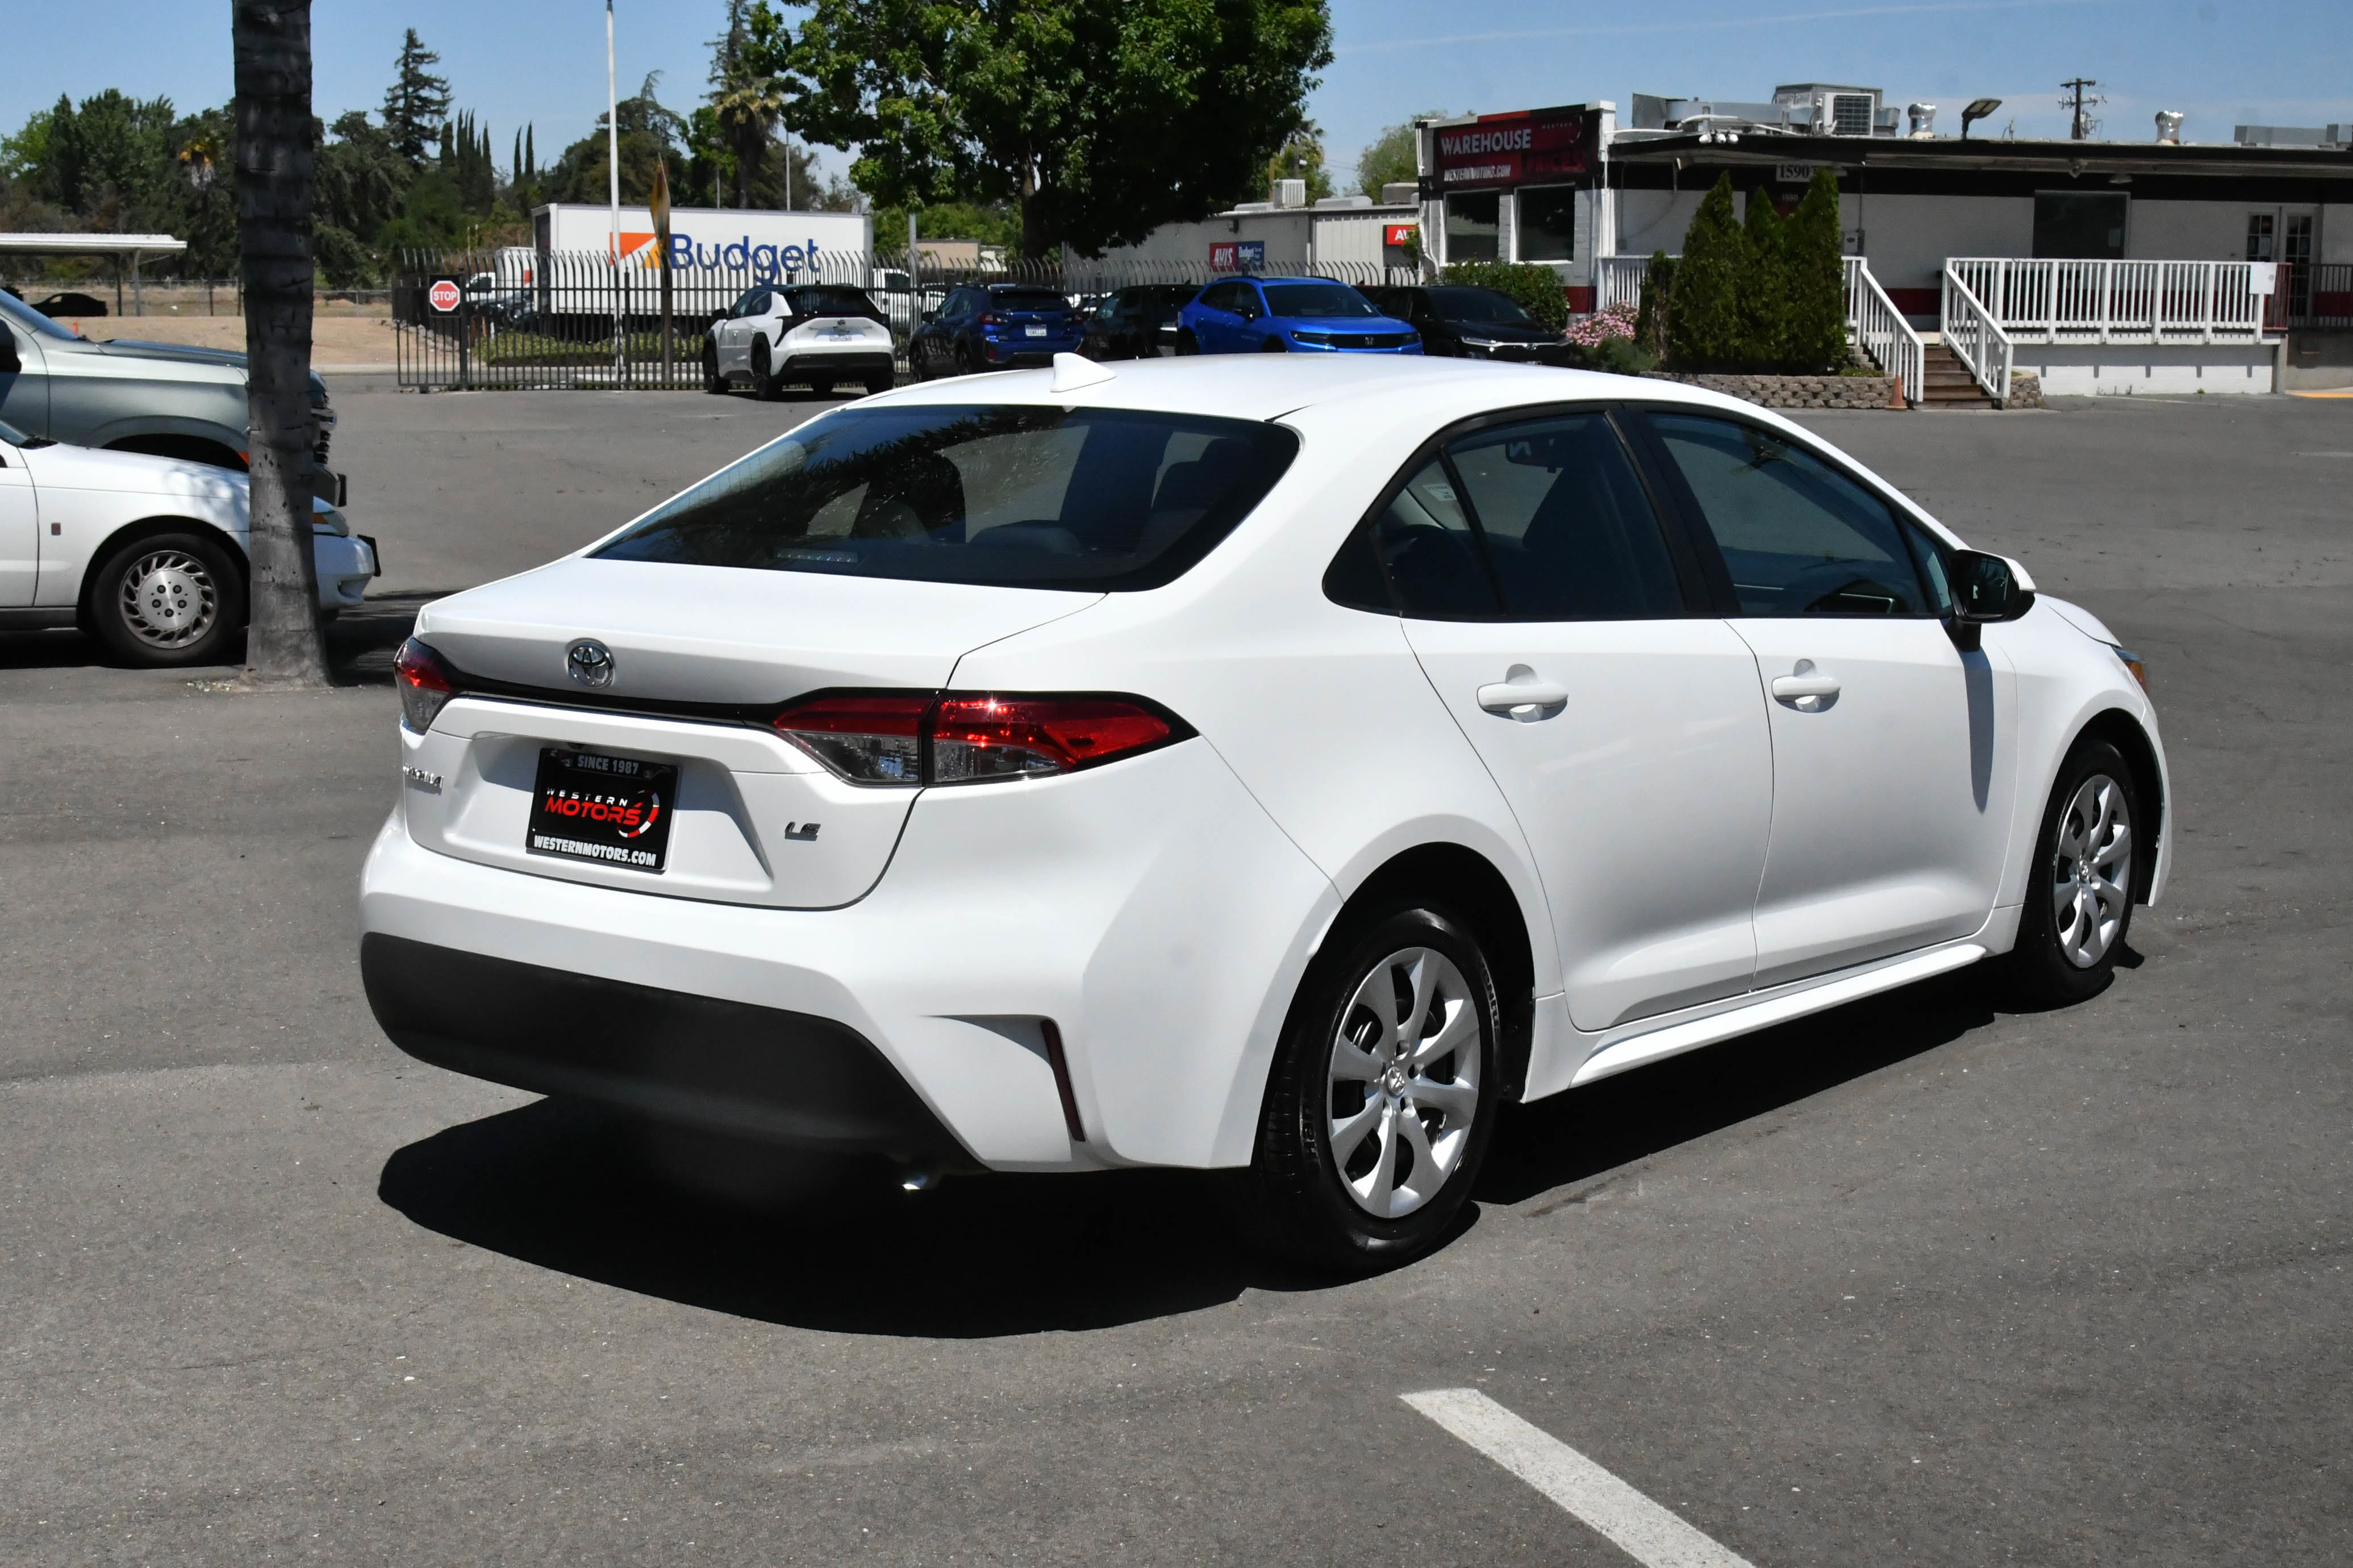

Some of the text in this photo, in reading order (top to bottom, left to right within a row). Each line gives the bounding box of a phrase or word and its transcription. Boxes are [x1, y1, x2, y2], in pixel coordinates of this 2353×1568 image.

[1441, 129, 1532, 157] WAREHOUSE
[1443, 165, 1511, 182] WESTERNMOTORS.COM
[1780, 164, 1810, 178] 1590
[670, 233, 819, 283] Budget
[1213, 248, 1233, 266] AVIS
[433, 291, 457, 301] STOP
[577, 755, 639, 775] SINCE 1987
[546, 787, 628, 806] WESTERN
[544, 796, 643, 825] MOTORS
[785, 821, 821, 841] LE
[533, 834, 657, 867] WESTERNMOTORS.COM
